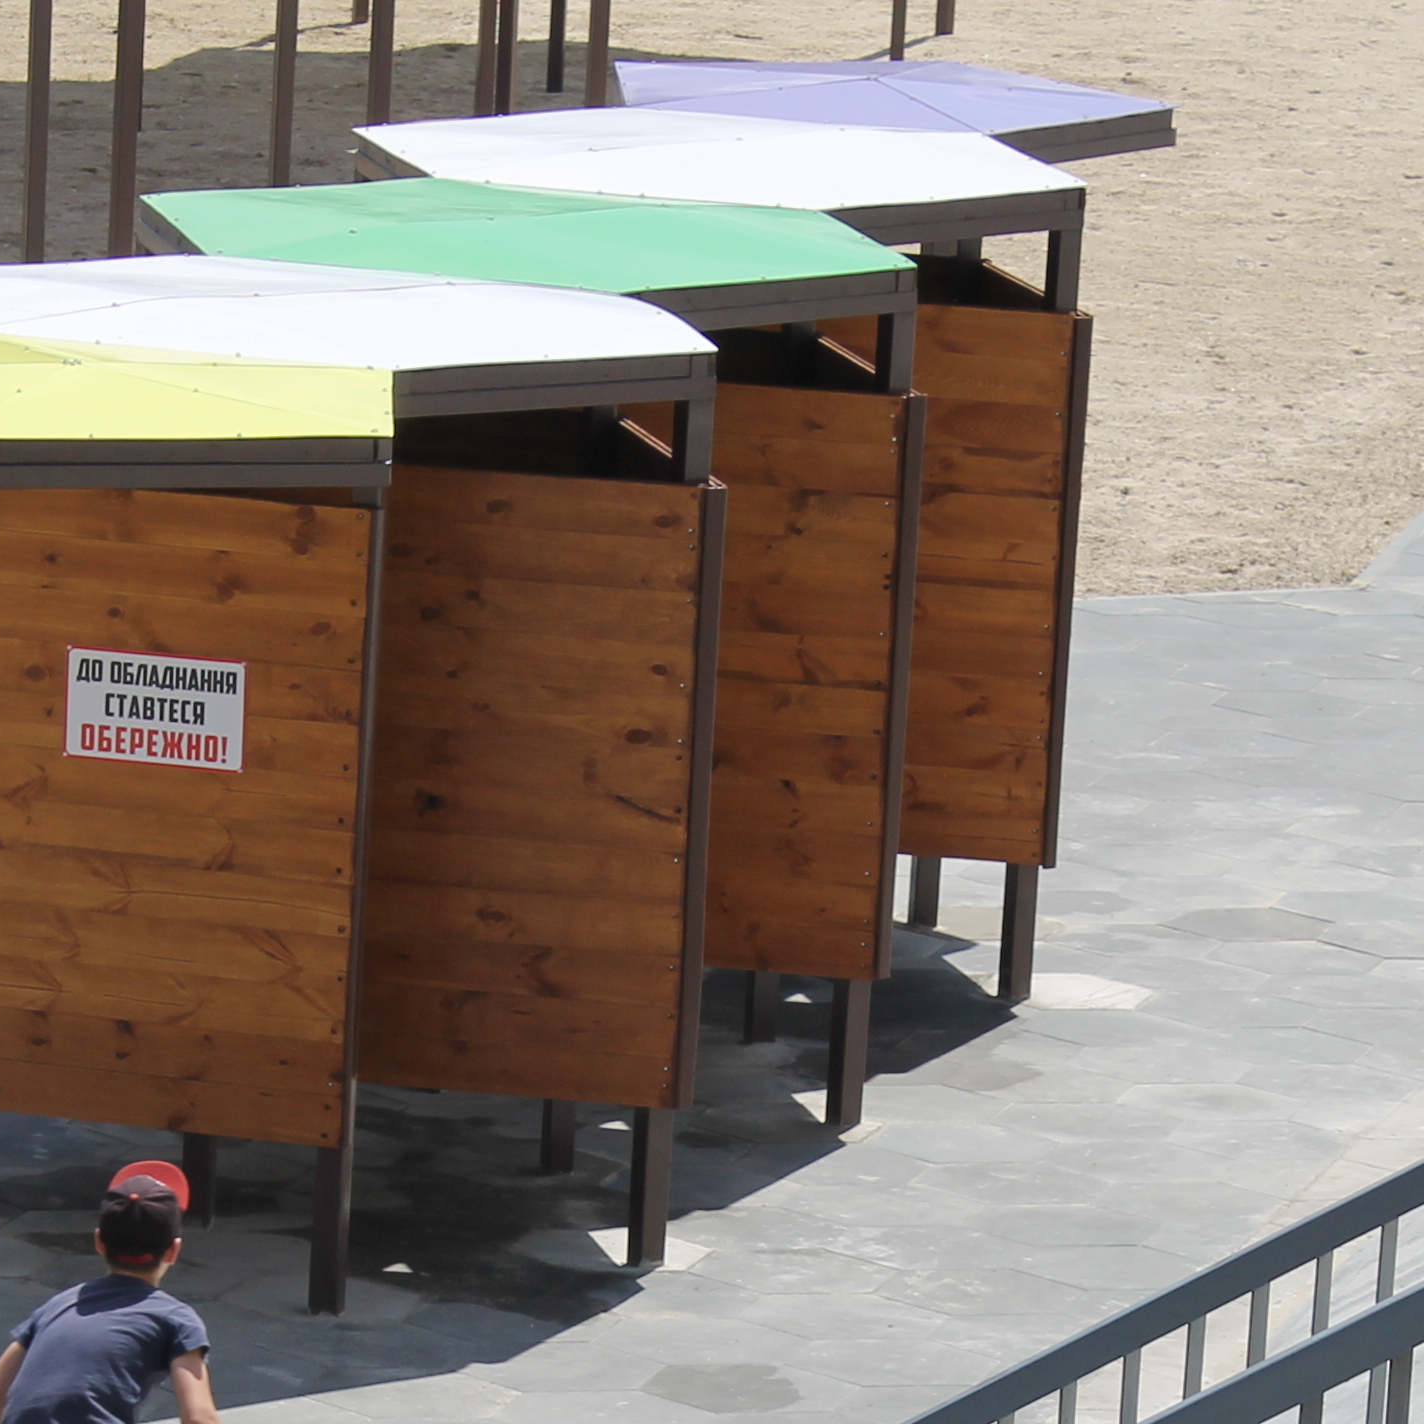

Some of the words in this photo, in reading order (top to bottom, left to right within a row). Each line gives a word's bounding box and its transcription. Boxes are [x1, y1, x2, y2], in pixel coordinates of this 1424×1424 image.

[76, 658, 103, 683] ДО
[110, 661, 237, 695] ОБЛАДНАННЯ
[105, 693, 206, 725] СТАВТЕСЯ
[81, 723, 228, 763] ОБЕРЕЖНО!
